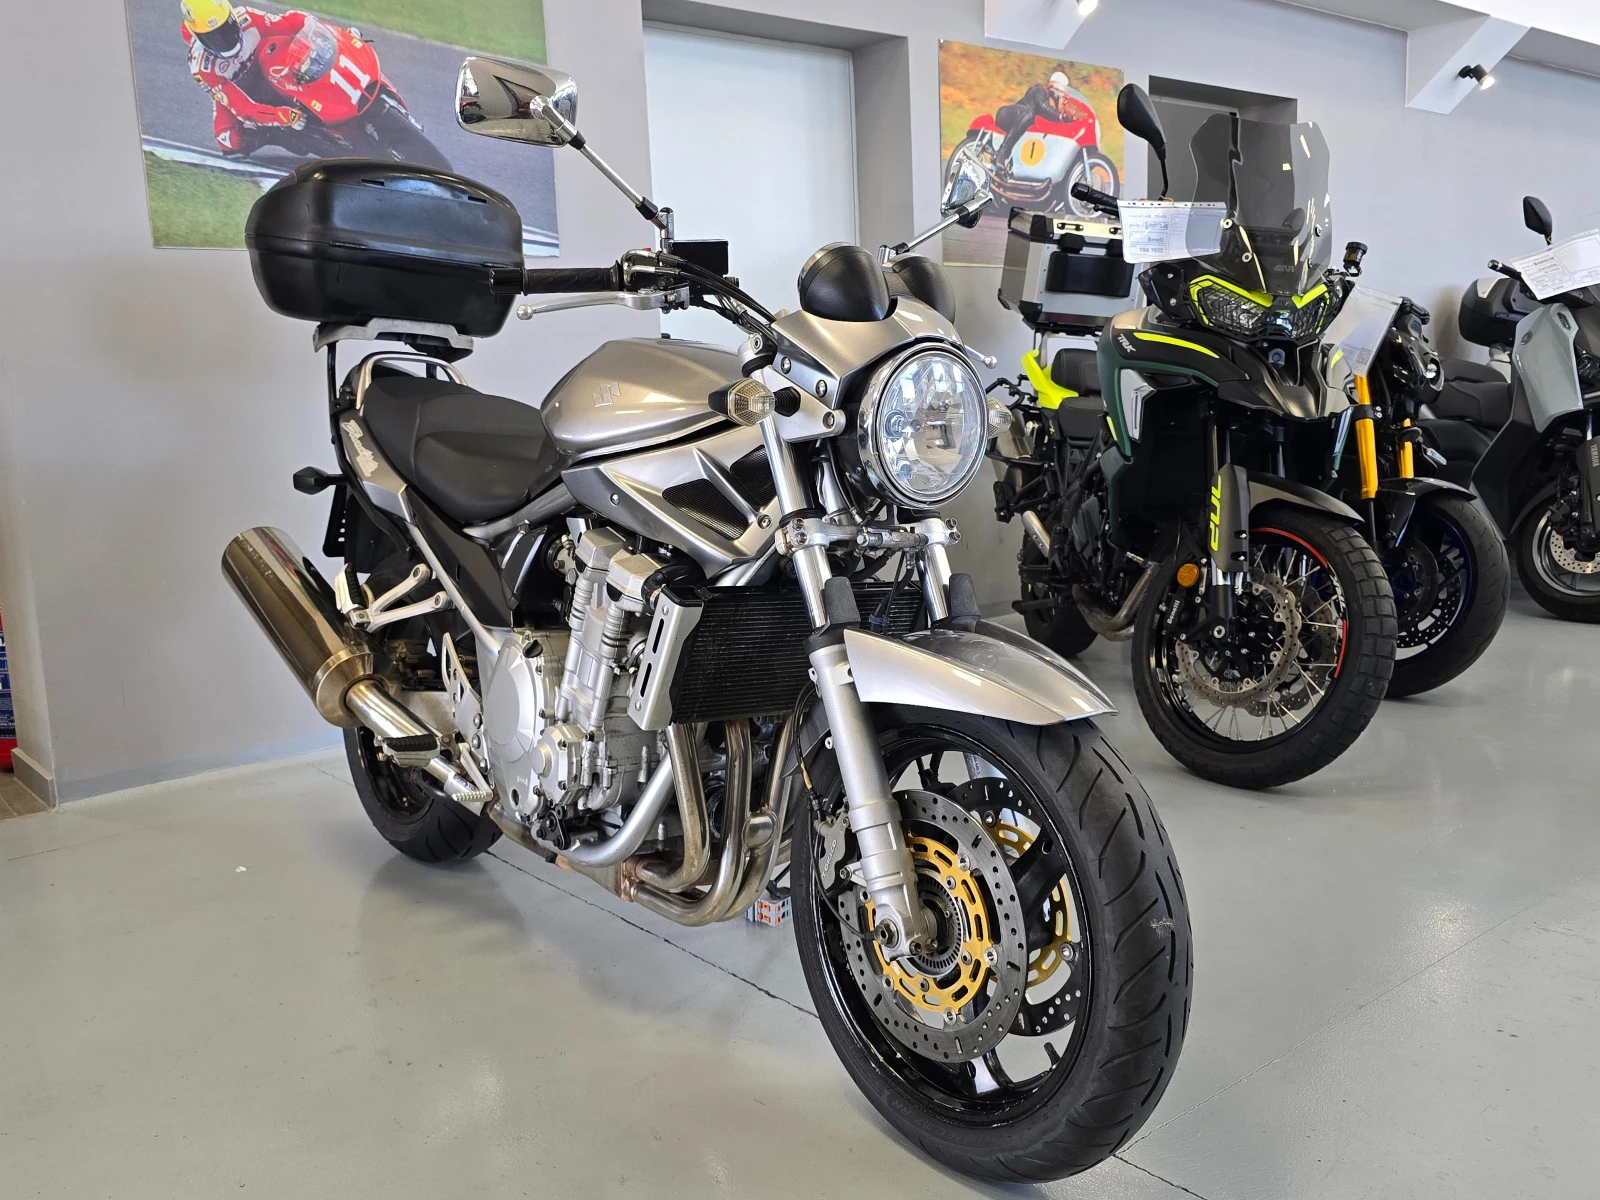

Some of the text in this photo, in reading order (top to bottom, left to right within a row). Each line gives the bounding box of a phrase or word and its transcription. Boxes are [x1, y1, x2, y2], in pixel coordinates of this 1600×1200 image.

[330, 54, 371, 105] 11
[1030, 141, 1036, 159] 1
[1273, 264, 1295, 273] GIVI
[1590, 443, 1600, 467] YAMAHA
[1166, 599, 1180, 625] Benelli
[822, 839, 837, 878] TOKICO
